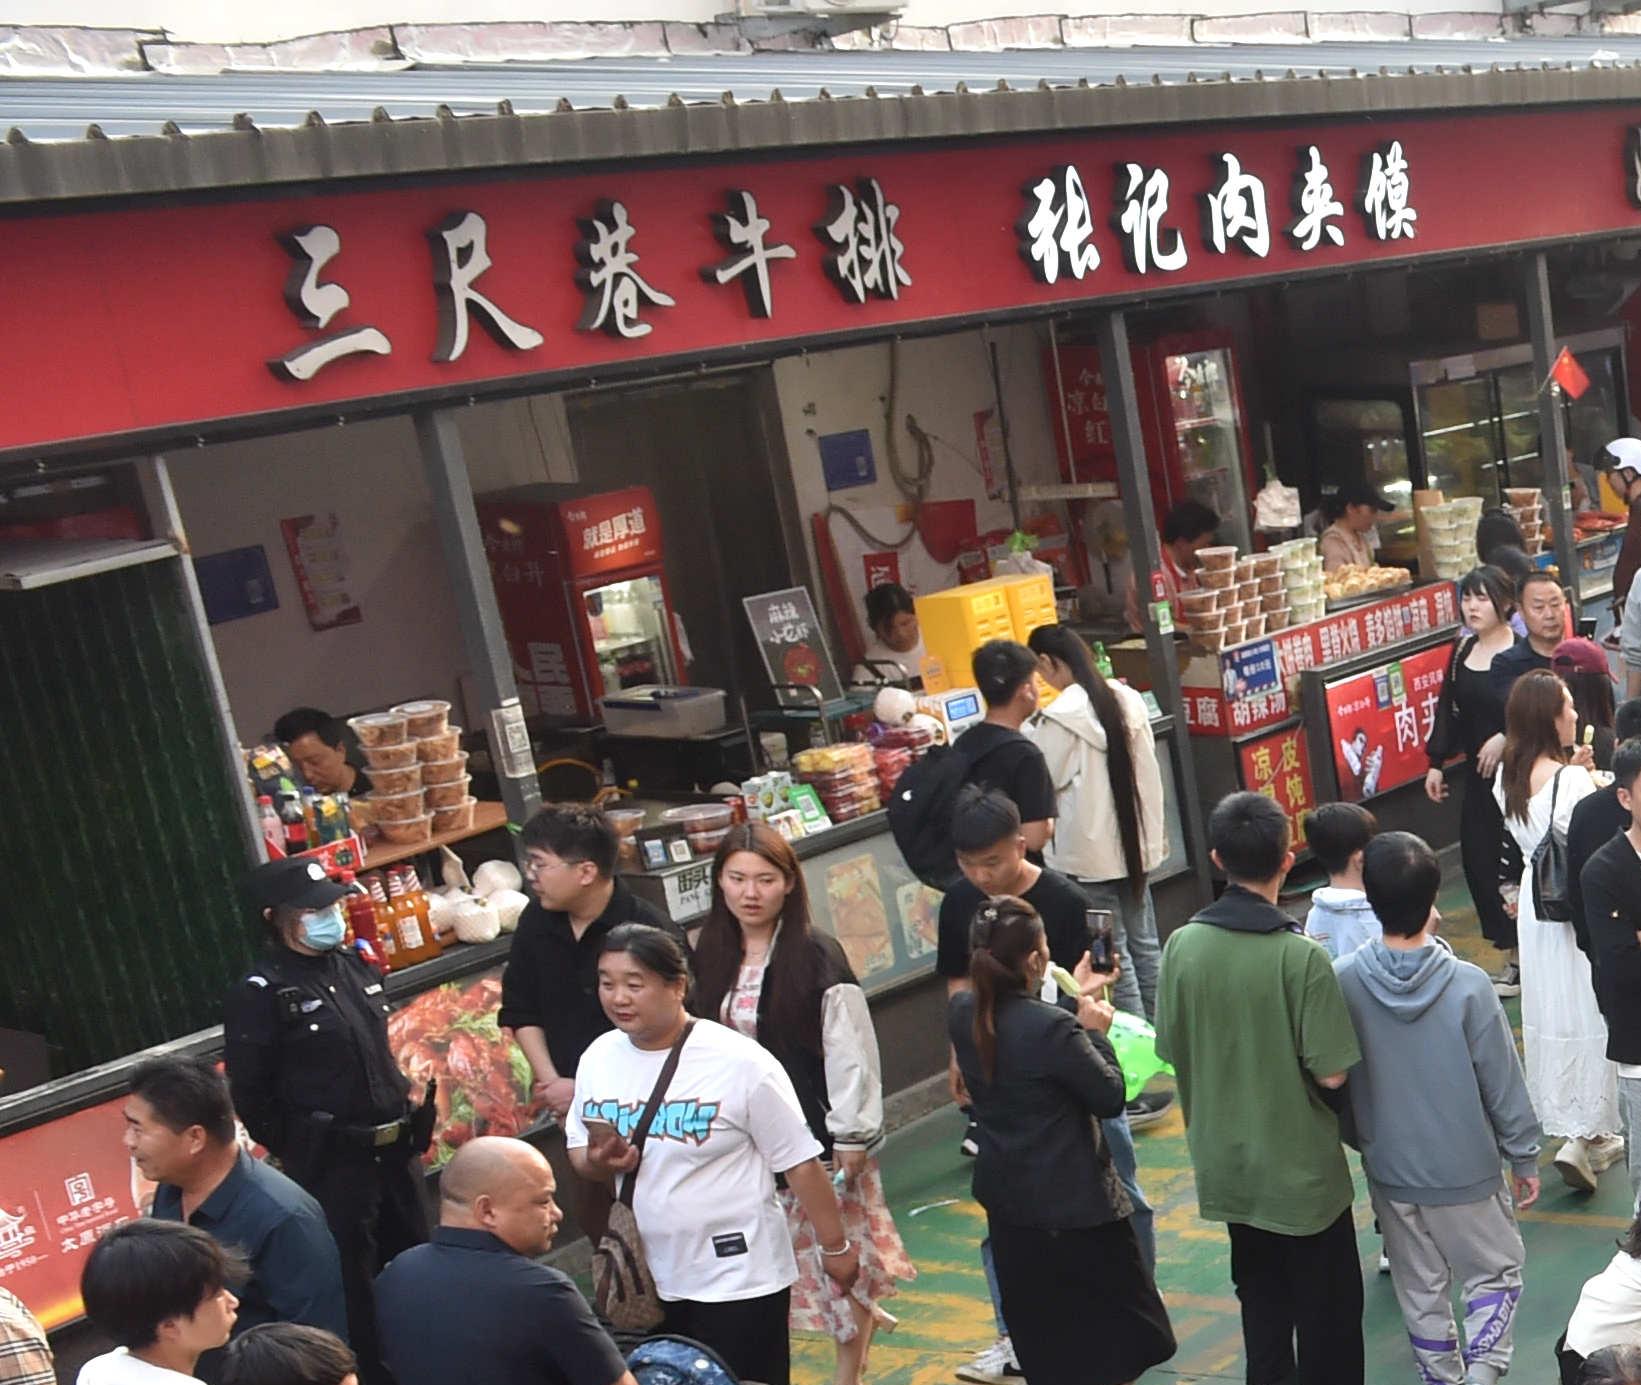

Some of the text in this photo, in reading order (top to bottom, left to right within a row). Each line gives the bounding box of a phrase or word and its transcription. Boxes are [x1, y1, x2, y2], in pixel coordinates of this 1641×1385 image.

[272, 177, 914, 383] 三尺巷牛排
[1026, 140, 1418, 284] 张记肉夹馍
